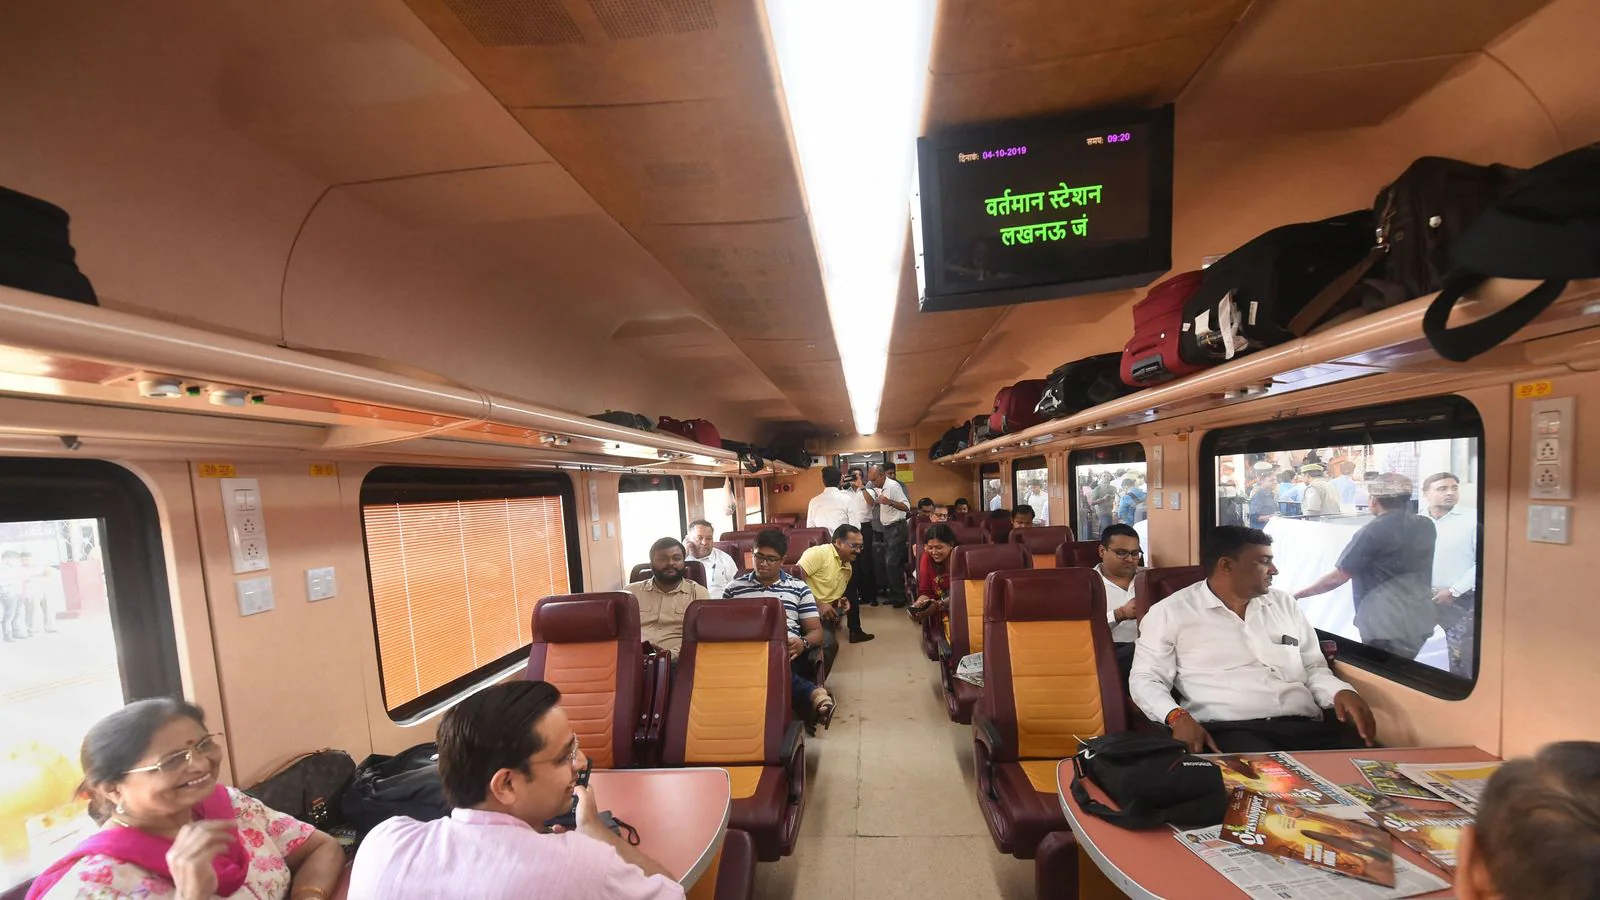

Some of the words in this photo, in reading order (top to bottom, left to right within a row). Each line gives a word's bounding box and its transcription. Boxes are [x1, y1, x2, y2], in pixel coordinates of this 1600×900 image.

[1107, 132, 1131, 143] 09:20
[982, 146, 1027, 160] 04-10-2019
[984, 188, 1045, 217] वर्तमान
[1048, 182, 1103, 209] स्टेशन
[1000, 220, 1067, 246] लखनऊ
[1071, 213, 1089, 237] जं
